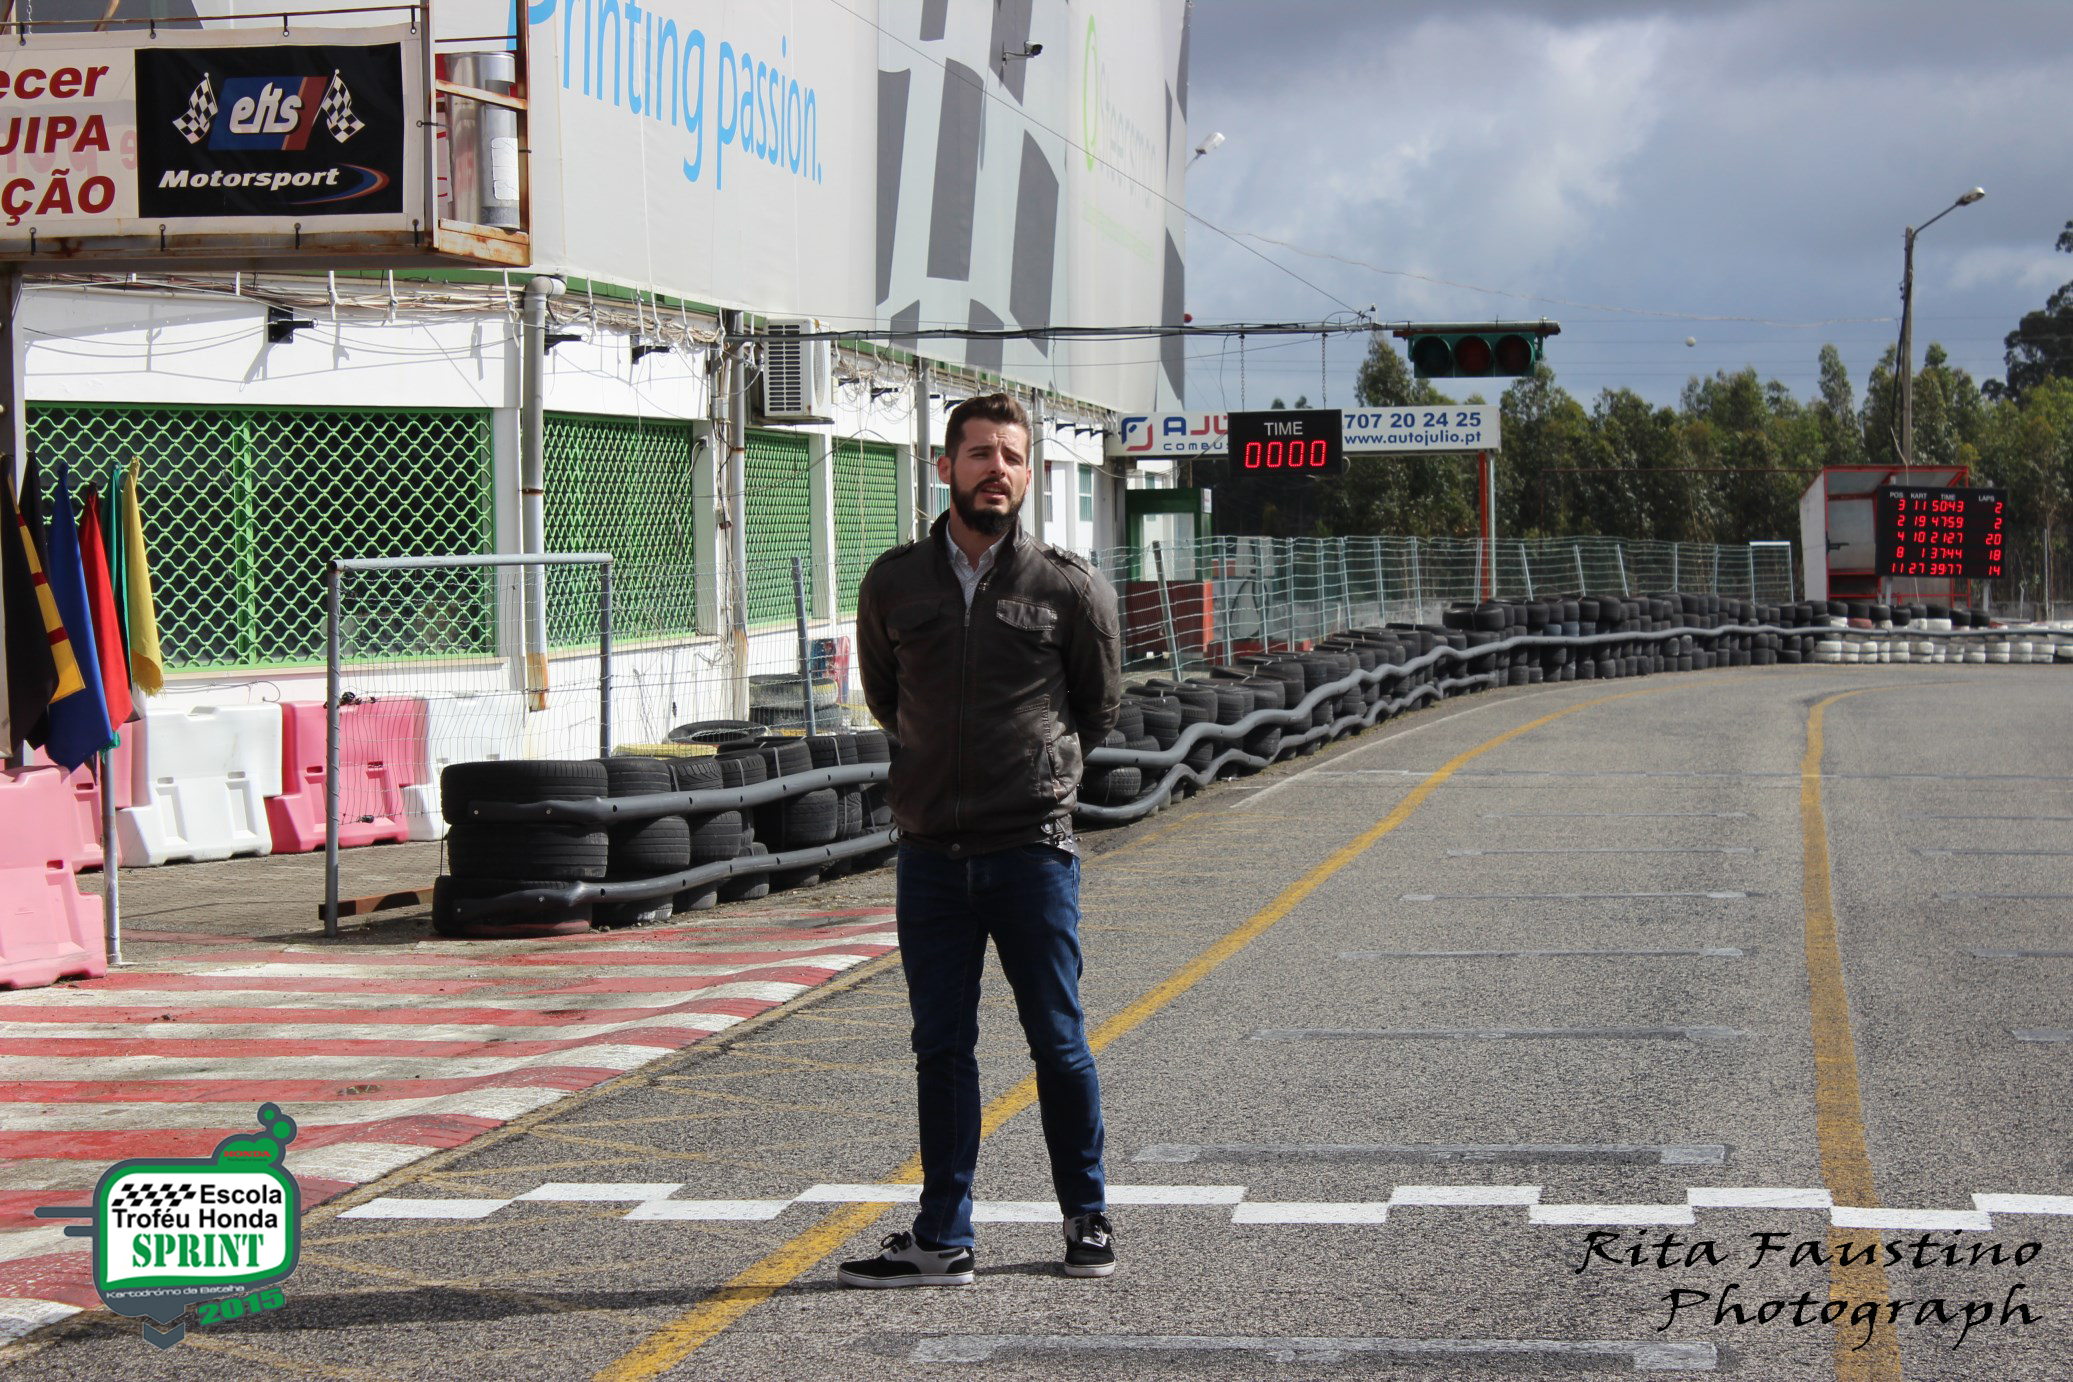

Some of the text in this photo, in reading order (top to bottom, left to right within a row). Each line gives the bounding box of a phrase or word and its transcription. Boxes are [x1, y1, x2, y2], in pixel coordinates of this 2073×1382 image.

[717, 34, 822, 190] passion.
[158, 168, 340, 191] Motorsport
[1344, 412, 1481, 429] 707 20 24 25
[1263, 421, 1303, 436] TIME
[1344, 429, 1481, 446] www.autojulio.pt
[1163, 442, 1228, 451] COMBU
[1914, 516, 1926, 527] 19
[1914, 531, 1926, 543] 10
[1985, 533, 2002, 545] 20
[1989, 549, 2001, 561] 18
[1891, 562, 1904, 573] 11
[1908, 562, 1925, 574] 27
[1988, 565, 2001, 576] 14
